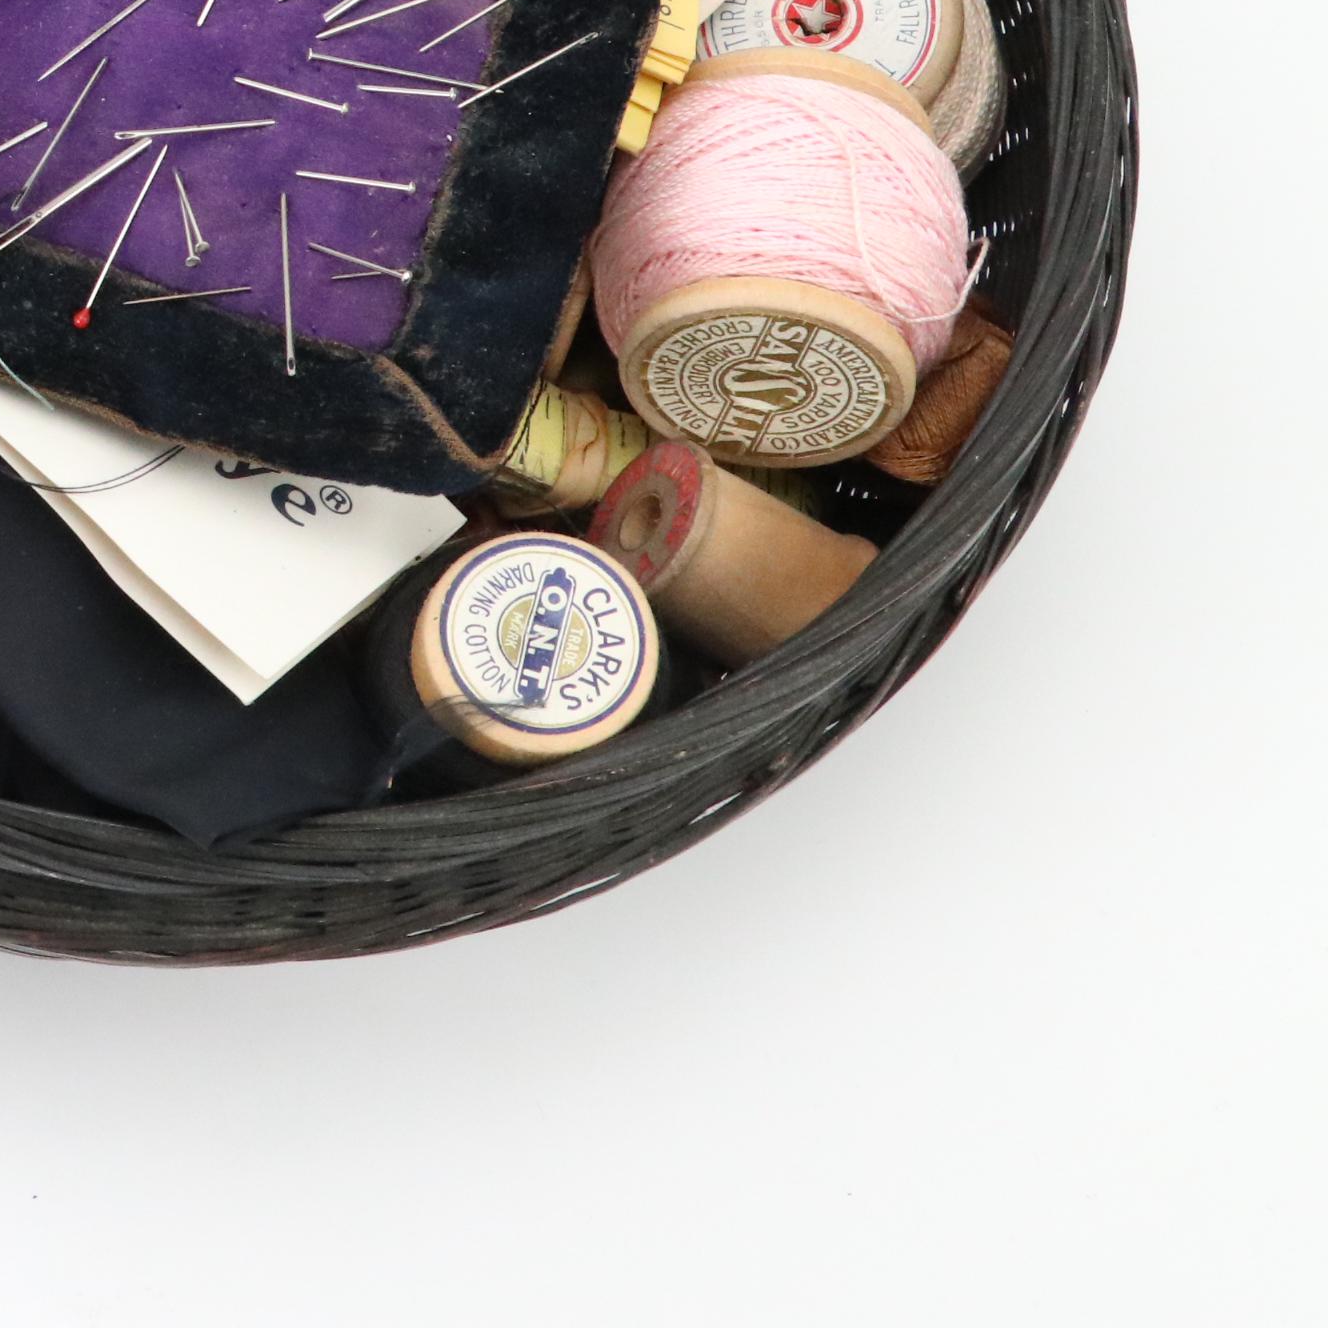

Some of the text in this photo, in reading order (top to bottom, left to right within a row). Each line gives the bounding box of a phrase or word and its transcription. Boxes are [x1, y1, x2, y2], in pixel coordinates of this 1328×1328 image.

[671, 320, 753, 359] CROCHET
[818, 337, 880, 407] AMERICAN
[687, 342, 745, 406] EMBROIDERY
[780, 360, 842, 430] 100 YARDS
[804, 405, 873, 448] THREAD
[465, 561, 534, 694] DARNING COTTON
[504, 611, 526, 650] MARK
[520, 586, 567, 689] O.N.T.
[559, 587, 625, 710] CLARK'S
[562, 628, 583, 666] TRADE
